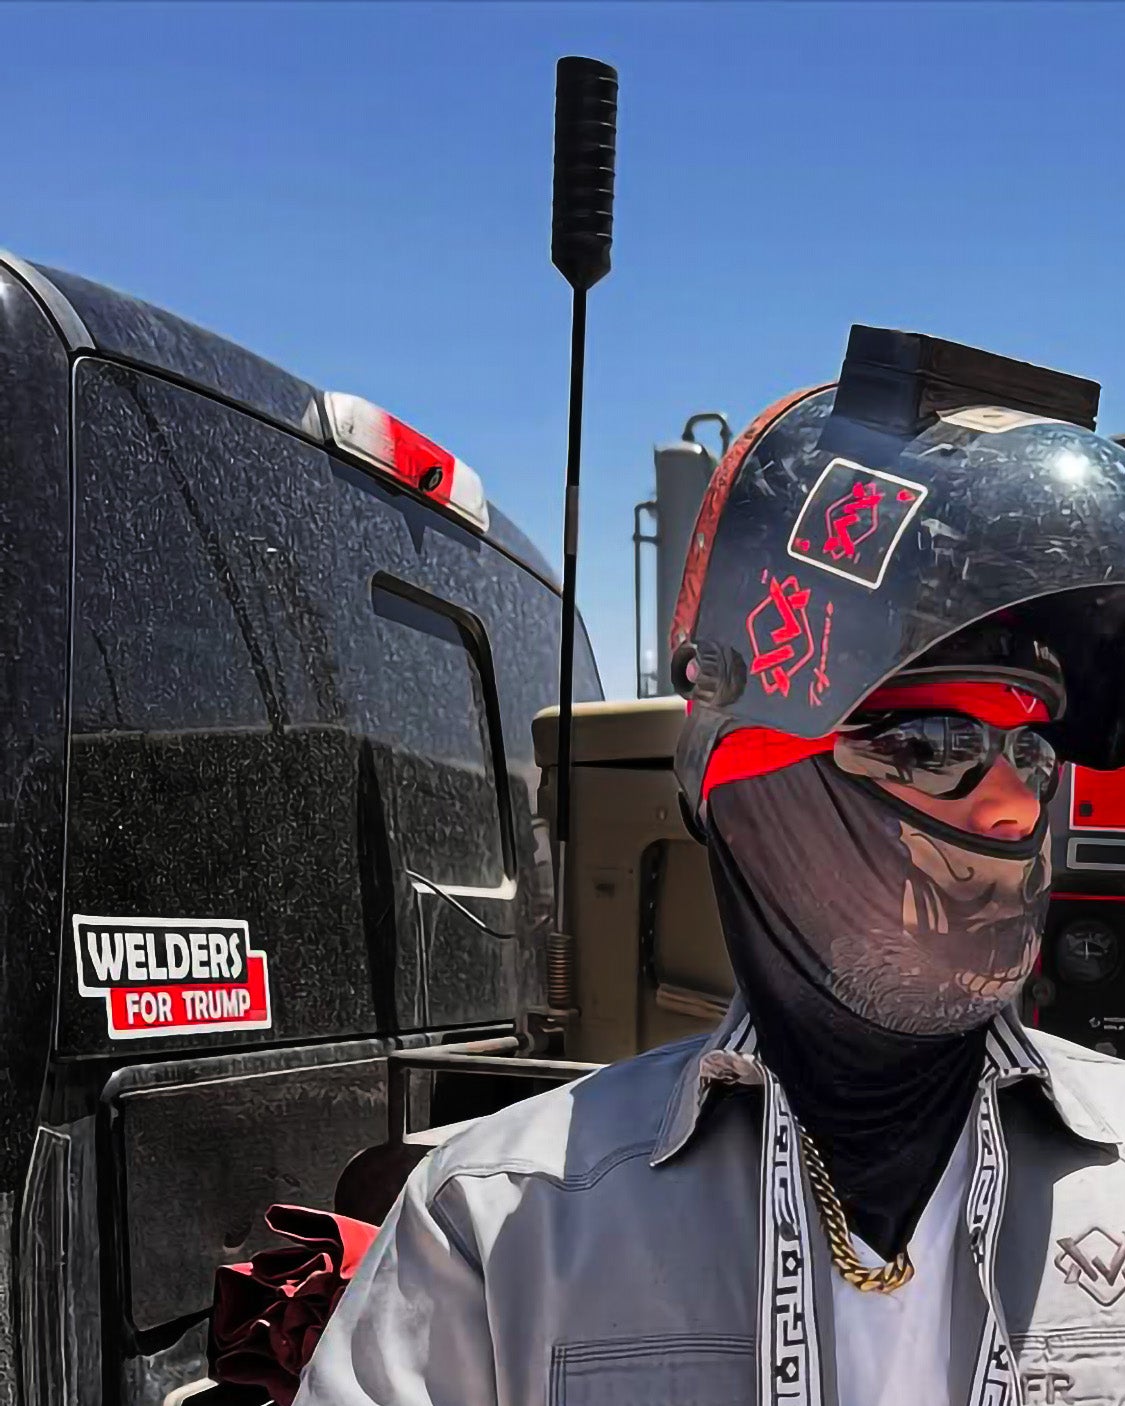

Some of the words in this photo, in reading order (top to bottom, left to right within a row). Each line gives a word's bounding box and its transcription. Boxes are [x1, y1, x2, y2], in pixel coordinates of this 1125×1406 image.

[86, 931, 243, 981] WELDERS
[125, 991, 174, 1025] FOR
[182, 988, 251, 1021] TRUMP
